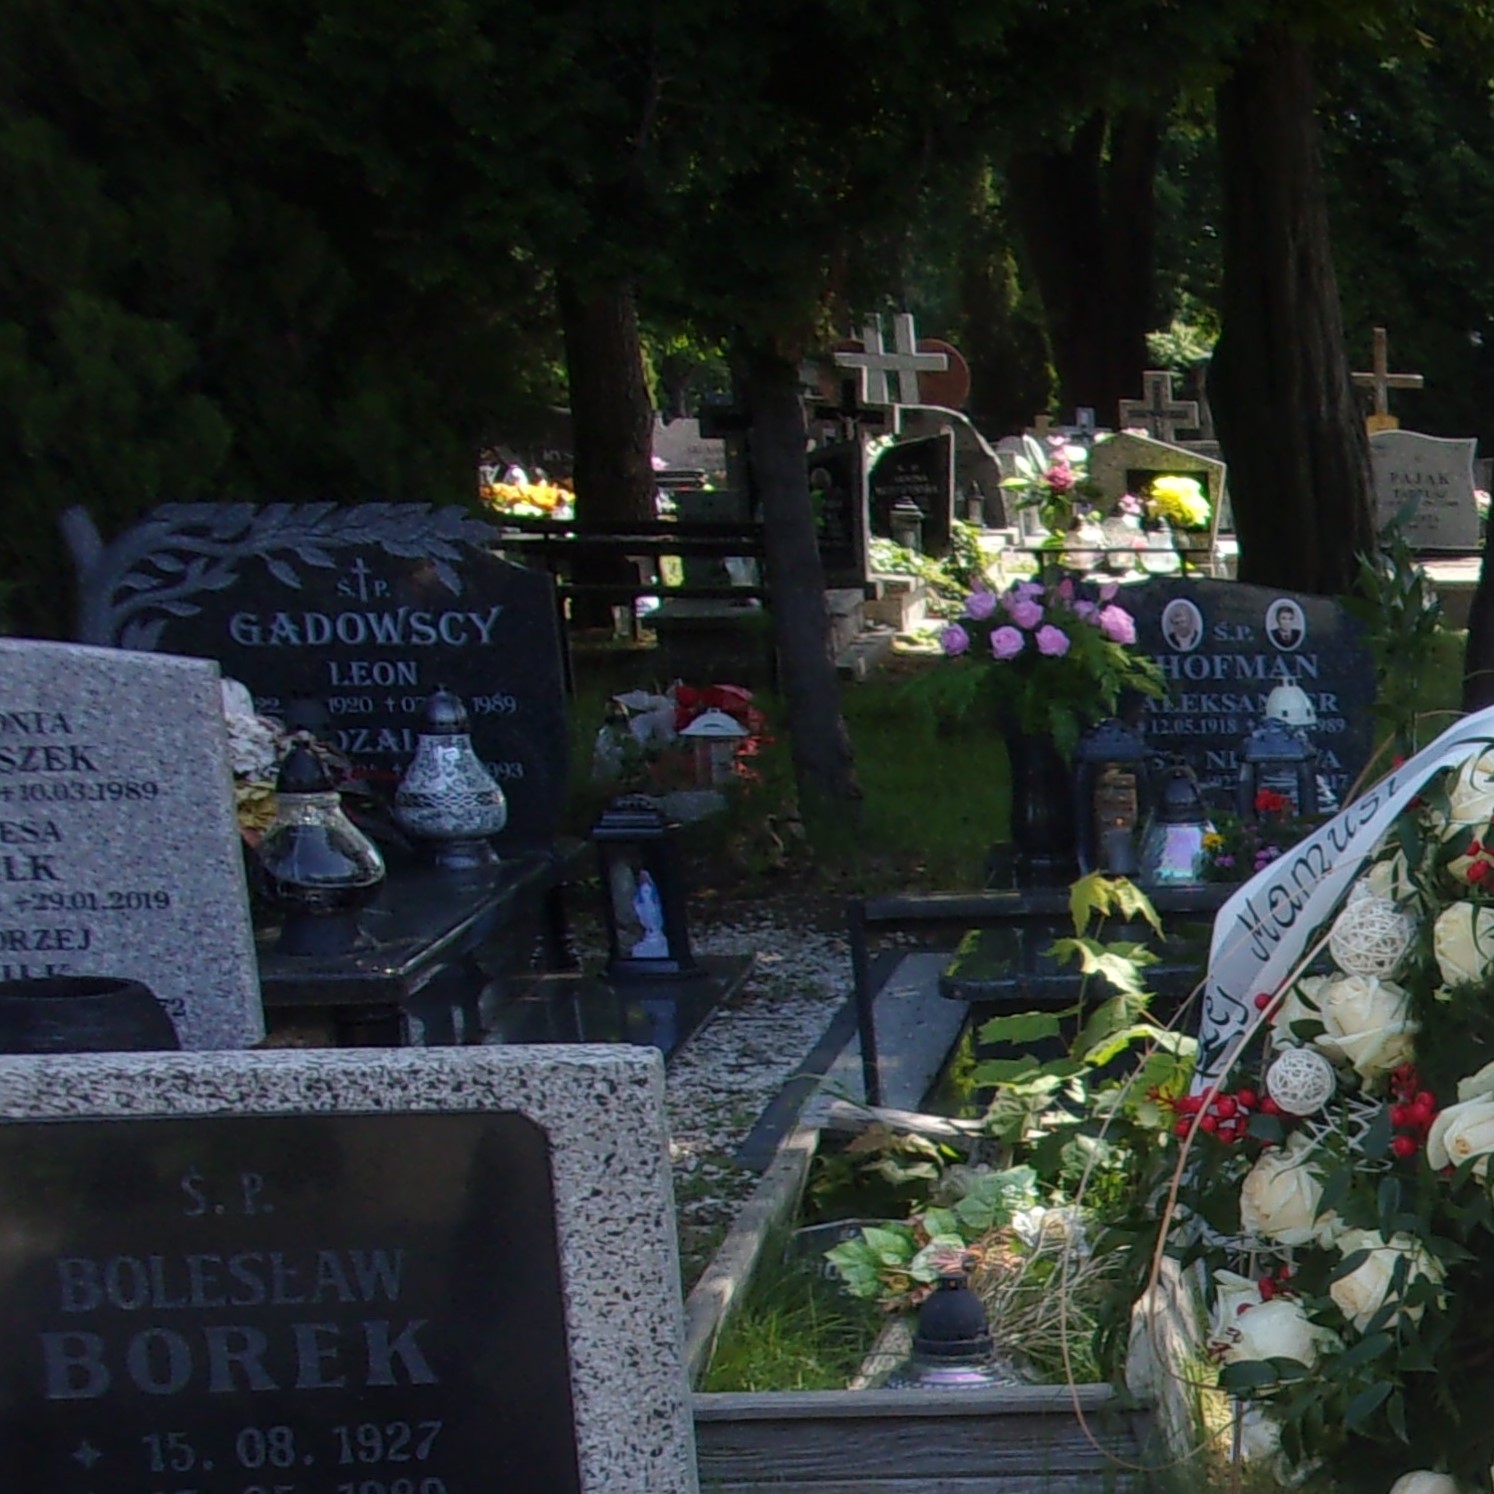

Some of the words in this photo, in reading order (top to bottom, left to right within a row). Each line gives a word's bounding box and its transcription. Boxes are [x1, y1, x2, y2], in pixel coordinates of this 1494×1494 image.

[228, 604, 504, 647] GADOWSCY
[328, 660, 419, 687] LEON
[1155, 653, 1320, 681] HOFMAN
[471, 692, 517, 713] 1989
[55, 1247, 405, 1313] BOLESŁAW
[38, 1317, 442, 1401] BOREK
[332, 1420, 444, 1466] 1927
